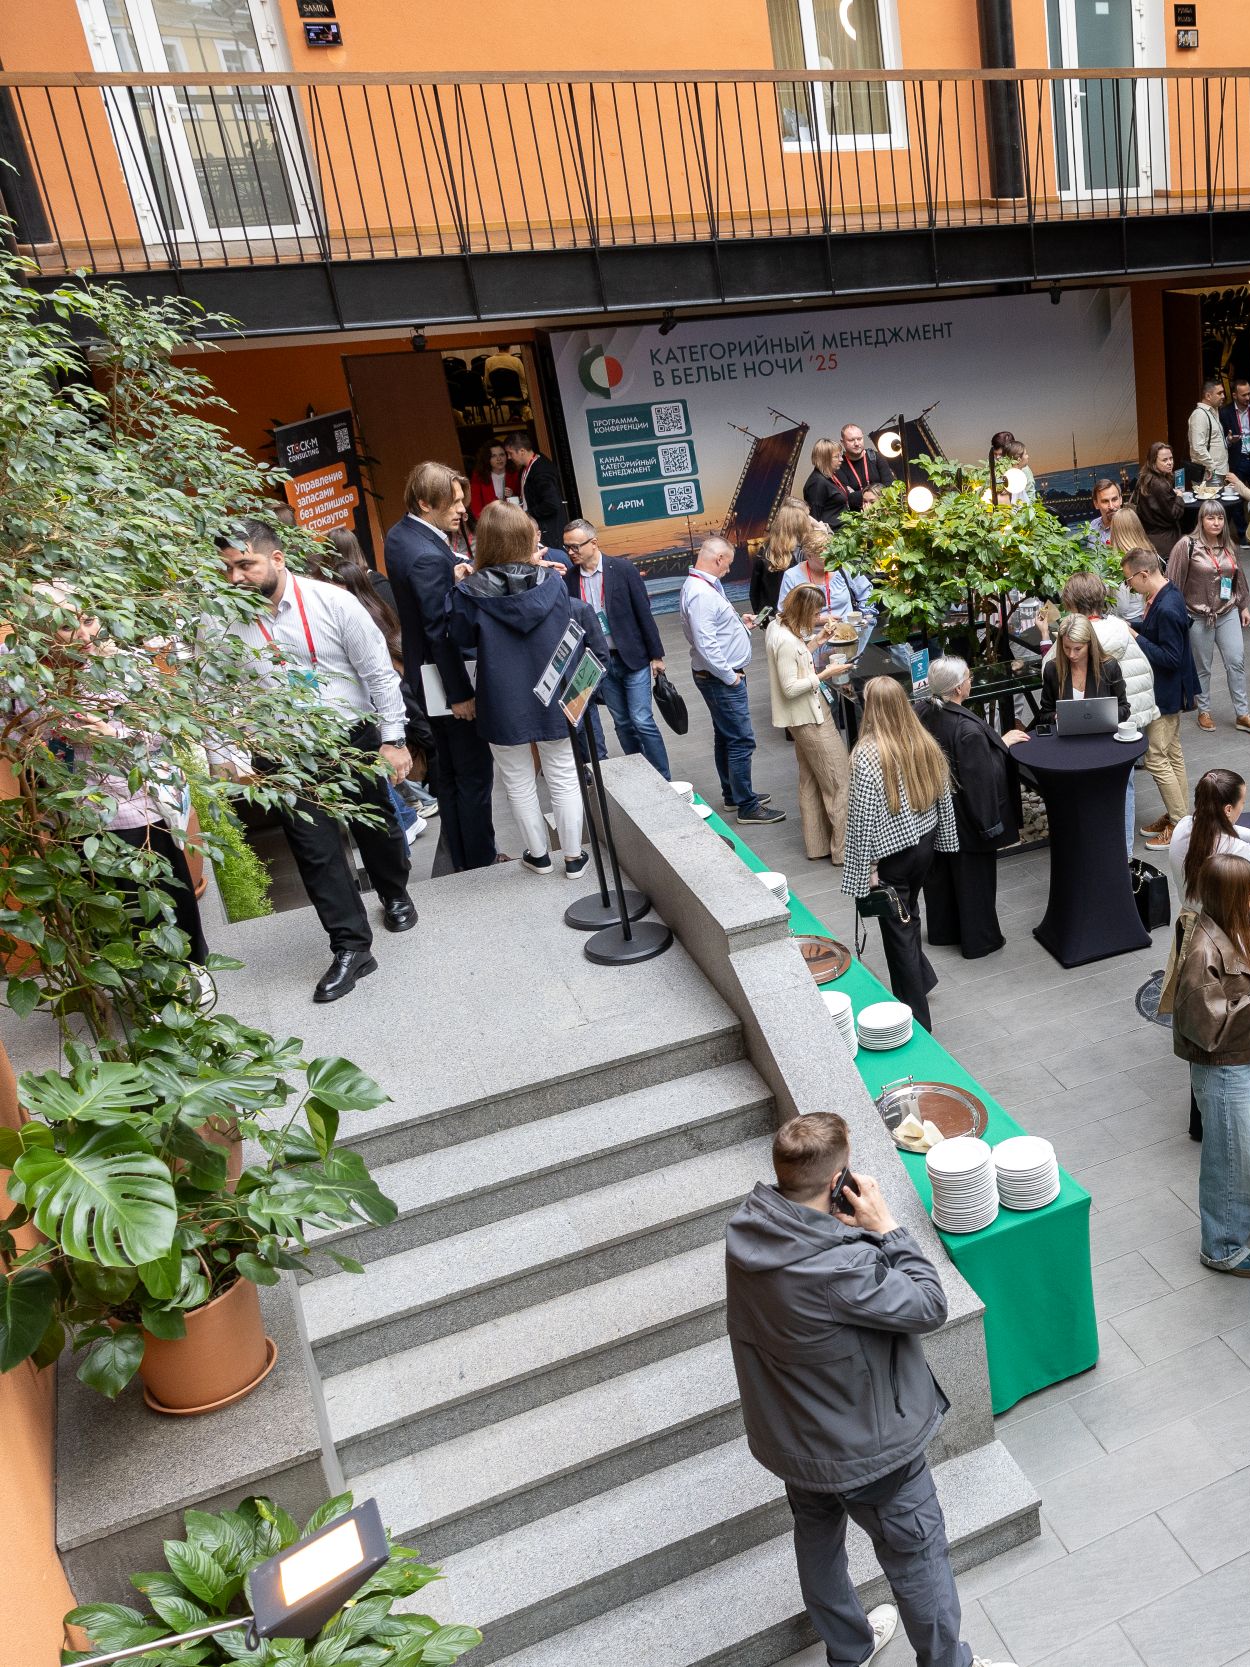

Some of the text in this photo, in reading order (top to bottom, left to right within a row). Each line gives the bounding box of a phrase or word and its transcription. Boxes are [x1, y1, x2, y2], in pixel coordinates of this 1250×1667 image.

[650, 322, 953, 366] КАТЕГОРИЙНЫЙ МЕНЕДЖМЕНТ
[653, 370, 665, 387] В
[671, 363, 738, 386] БЕЛЫЕ
[743, 356, 803, 379] НОЧИ
[592, 416, 639, 427] ПРОГРАММА
[594, 422, 649, 434] КОНФЕРЕНЦИИ
[288, 447, 320, 463] CONSULTING
[599, 455, 625, 464] КАНАЛ
[600, 457, 657, 471] КАТЕГОРИЙНЫЙ
[602, 465, 651, 478] МЕНЕДЖМЕНТ
[294, 470, 343, 495] Управление
[297, 487, 335, 508] запасами
[299, 493, 354, 520] без излишков
[308, 508, 349, 531] стокаутов
